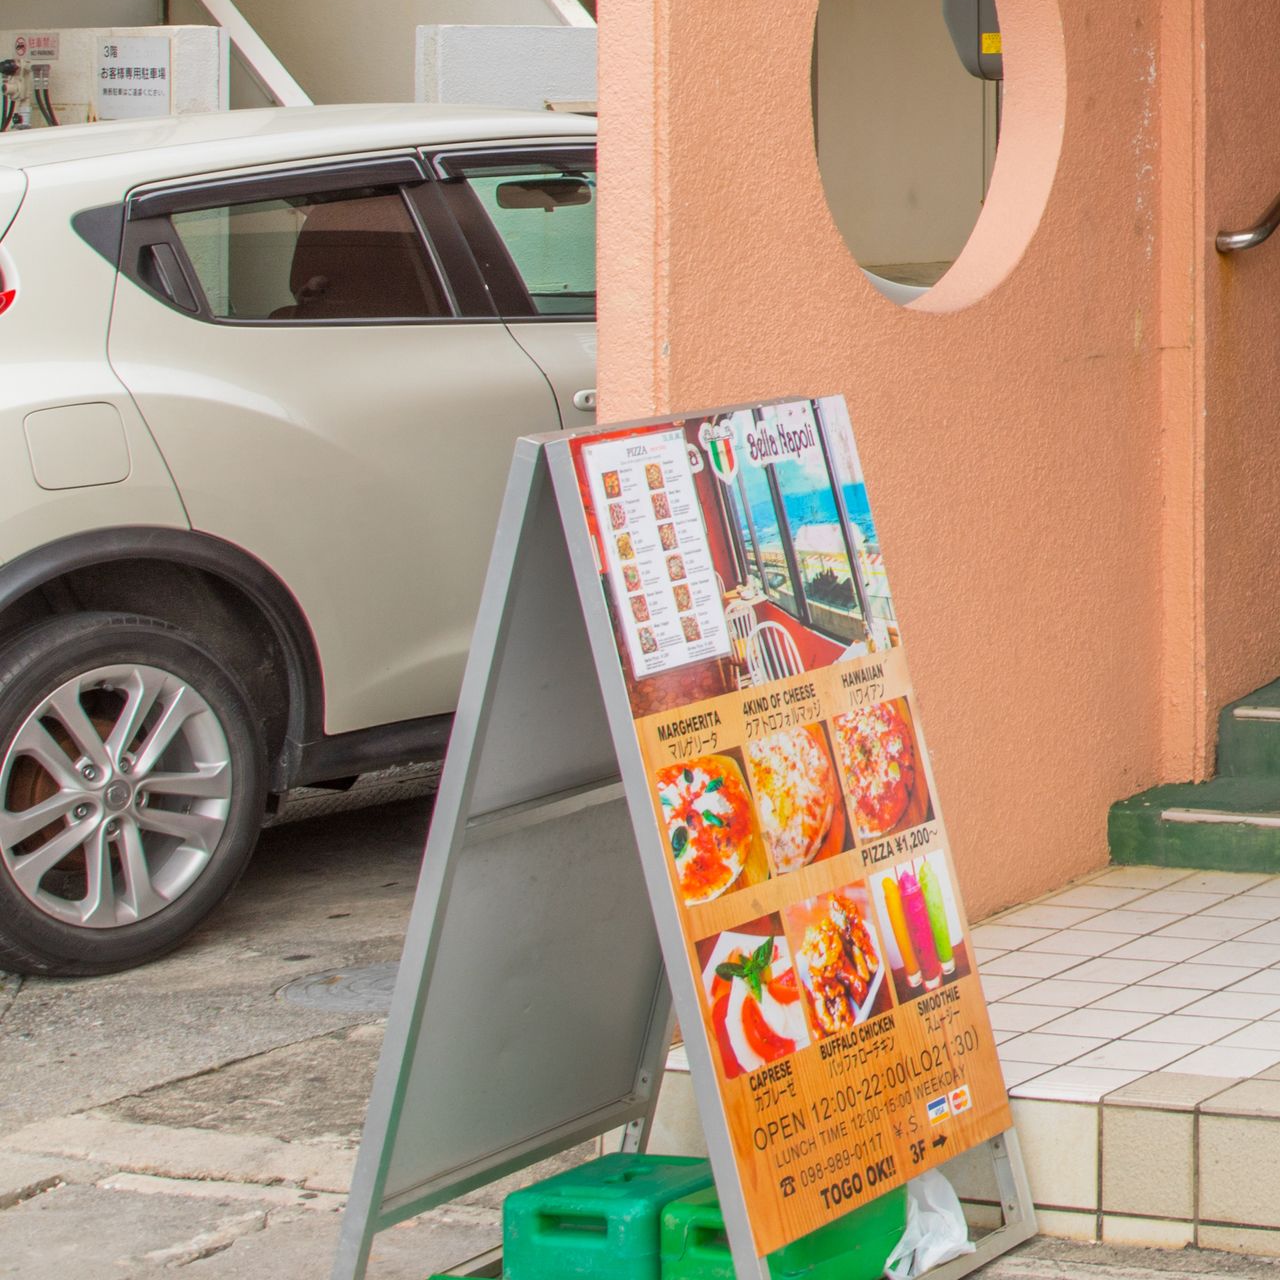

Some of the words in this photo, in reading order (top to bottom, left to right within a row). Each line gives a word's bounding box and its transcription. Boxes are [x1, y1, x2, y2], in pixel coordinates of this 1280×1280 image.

[103, 45, 118, 58] 3階
[101, 67, 166, 80] お客様専用駐車場
[626, 445, 648, 458] PIZZA
[747, 426, 779, 461] Bella
[776, 422, 816, 459] Napoli
[841, 663, 885, 689] HAWAIIAN
[770, 692, 781, 709] OF
[783, 683, 816, 705] CHEESE
[848, 682, 885, 708] ハワイアン
[657, 710, 721, 742] MARGHERITA
[745, 699, 821, 739] クアトロフォルマッジ
[668, 732, 718, 760] マルゲリータ
[861, 840, 895, 867] PIZZA
[917, 986, 961, 1017] SMOOTHIE
[924, 1007, 961, 1034] スムージー
[819, 1032, 858, 1060] BUFFALO
[858, 1015, 896, 1043] CHICKEN
[829, 1038, 895, 1079] バッファローチキン
[749, 1060, 793, 1092] CAPRESE
[753, 1112, 806, 1151] OPEN
[775, 1138, 816, 1169] LUNCH
[819, 1123, 848, 1144] TIME
[913, 1064, 967, 1100] WEEKDAY
[800, 1132, 884, 1188] 098-989-0117
[820, 1173, 863, 1209] TOGO
[866, 1155, 897, 1187] OK!!
[909, 1138, 926, 1165] 3F
